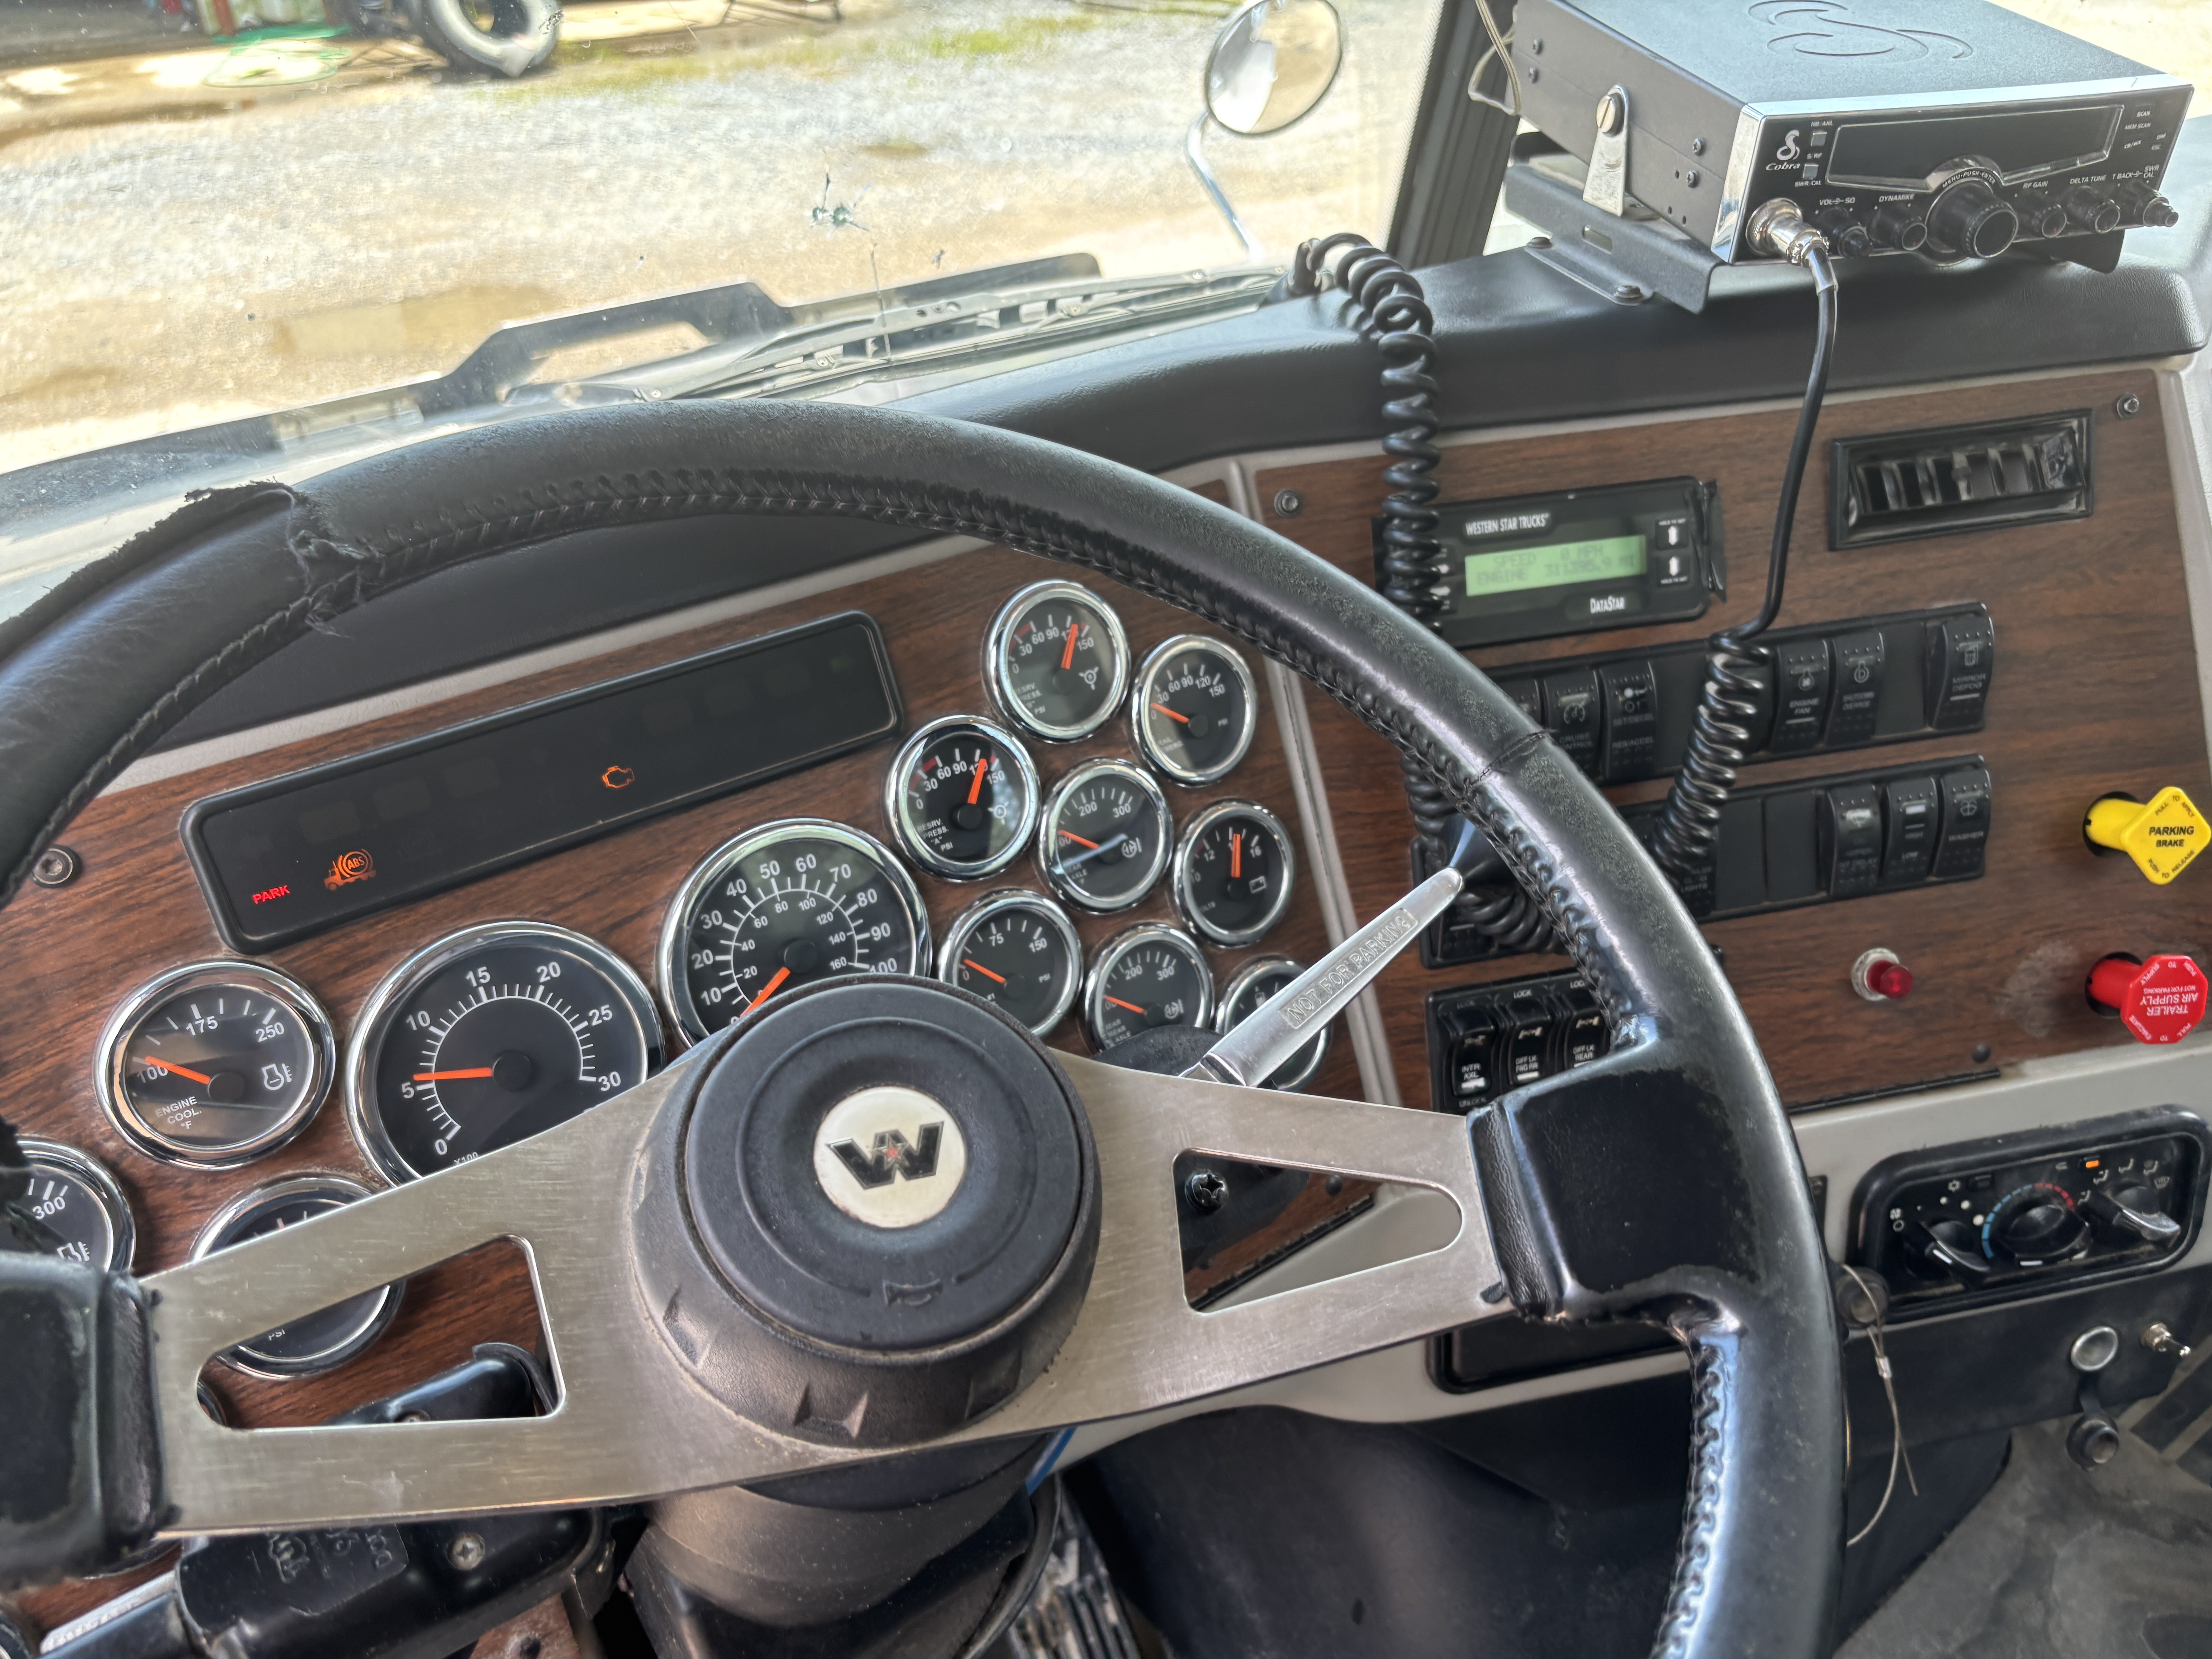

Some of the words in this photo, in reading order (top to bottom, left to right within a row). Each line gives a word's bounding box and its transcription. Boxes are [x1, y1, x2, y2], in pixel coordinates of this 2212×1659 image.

[1766, 162, 1800, 171] Cobra
[2070, 176, 2089, 184] DELTA
[1879, 193, 1915, 203] DYNAMIKE
[1465, 519, 1499, 536] WESTERN
[1500, 517, 1518, 532] STAR
[1578, 544, 1603, 560] MPH
[1032, 632, 1045, 645] 60
[1046, 627, 1060, 640] 90
[1019, 643, 1033, 656] 30
[1077, 637, 1094, 651] 150
[1012, 663, 1020, 674] 0
[1168, 681, 1181, 693] 60
[1181, 675, 1194, 688] 90
[1195, 677, 1211, 689] 120
[1209, 684, 1226, 697] 150
[1157, 692, 1169, 704] 30
[1790, 697, 1819, 708] ENGINE
[1151, 711, 1157, 720] 0
[1794, 707, 1812, 715] FAN
[937, 766, 951, 780] 60
[953, 761, 967, 775] 90
[986, 770, 1005, 785] 150
[924, 778, 938, 792] 30
[916, 799, 924, 810] 0
[1079, 801, 1098, 817] 200
[1113, 803, 1131, 818] 300
[1905, 831, 1923, 840] HIGH
[2148, 826, 2195, 836] PARKING
[941, 842, 953, 852] PSI
[1059, 836, 1072, 847] 00
[2155, 839, 2185, 848] BRAKE
[1204, 849, 1216, 862] 12
[347, 856, 365, 870] ABS
[759, 860, 781, 879] 50
[796, 853, 817, 873] 60
[830, 864, 852, 883] 70
[252, 884, 291, 905] PARK
[726, 878, 747, 897] 40
[799, 897, 816, 912] 100
[857, 888, 878, 908] 80
[775, 900, 788, 914] 80
[700, 909, 723, 929] 30
[754, 915, 768, 929] 60
[816, 911, 834, 926] 120
[871, 922, 891, 941] 90
[741, 939, 756, 952] 40
[828, 932, 846, 946] 140
[989, 933, 1005, 947] 75
[1029, 937, 1048, 953] 150
[691, 949, 714, 970] 20
[830, 956, 847, 971] 160
[869, 958, 898, 974] 100
[537, 960, 562, 983] 20
[743, 965, 758, 979] 20
[962, 970, 970, 981] 0
[1125, 964, 1143, 981] 200
[1156, 966, 1175, 981] 300
[1287, 988, 1322, 1023] NOT
[1319, 960, 1356, 996] FOR
[1355, 915, 1411, 970] PARKING
[465, 966, 491, 988] 15
[701, 986, 723, 1006] 10
[1513, 989, 1532, 999] LOCK
[2140, 994, 2180, 1006] SUPPLY
[2181, 993, 2199, 1003] AIR
[589, 1003, 614, 1026] 25
[2146, 1005, 2188, 1017] TRAILER
[186, 1015, 219, 1036] 175
[406, 1010, 431, 1031] 10
[255, 1022, 285, 1042] 250
[137, 1065, 169, 1084] 100
[598, 1070, 622, 1092] 30
[402, 1081, 415, 1099] 5
[155, 1096, 198, 1118] ENGINE
[167, 1109, 203, 1125] COOL.
[434, 1138, 448, 1156] 0
[33, 1196, 66, 1220] 300
[268, 1328, 286, 1341] PSI
